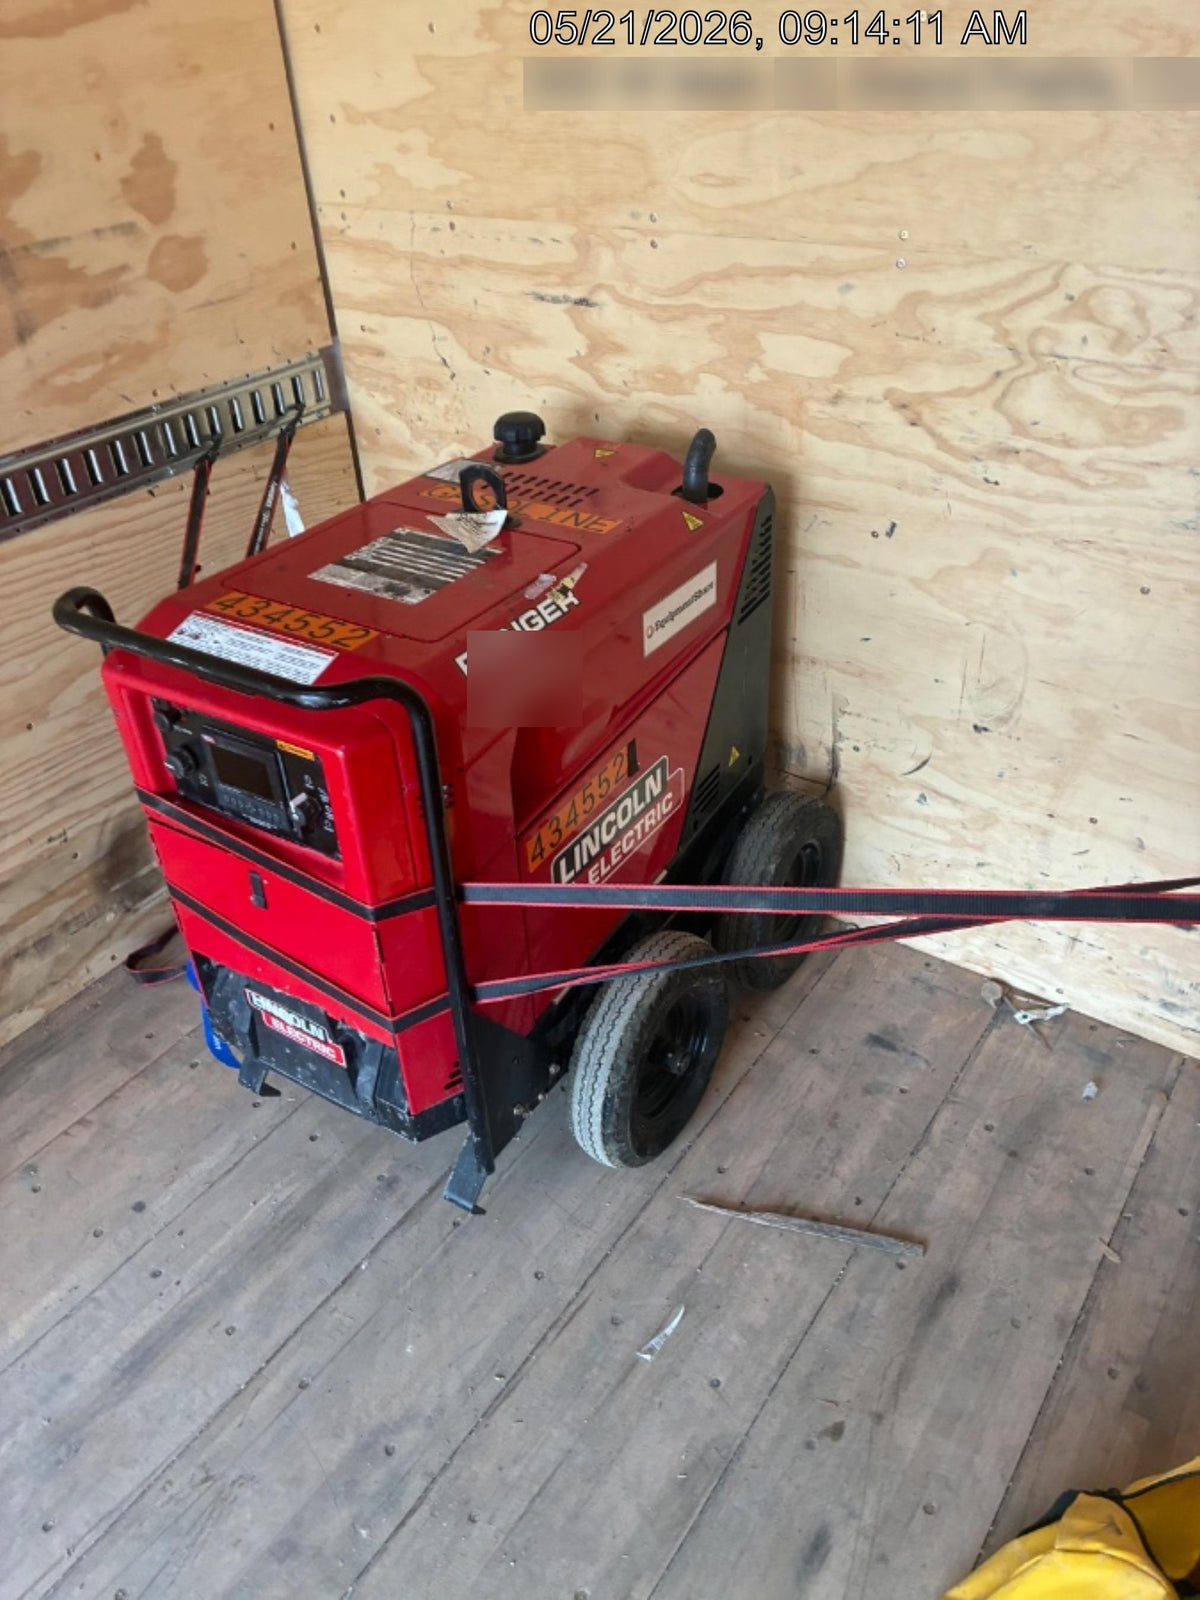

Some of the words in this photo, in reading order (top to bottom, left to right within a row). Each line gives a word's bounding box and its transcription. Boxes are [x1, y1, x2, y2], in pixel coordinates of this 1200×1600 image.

[213, 592, 371, 648] 434552
[531, 752, 626, 863] 434552
[559, 767, 663, 884] LINCOLN
[588, 792, 673, 885] ELECTRIC
